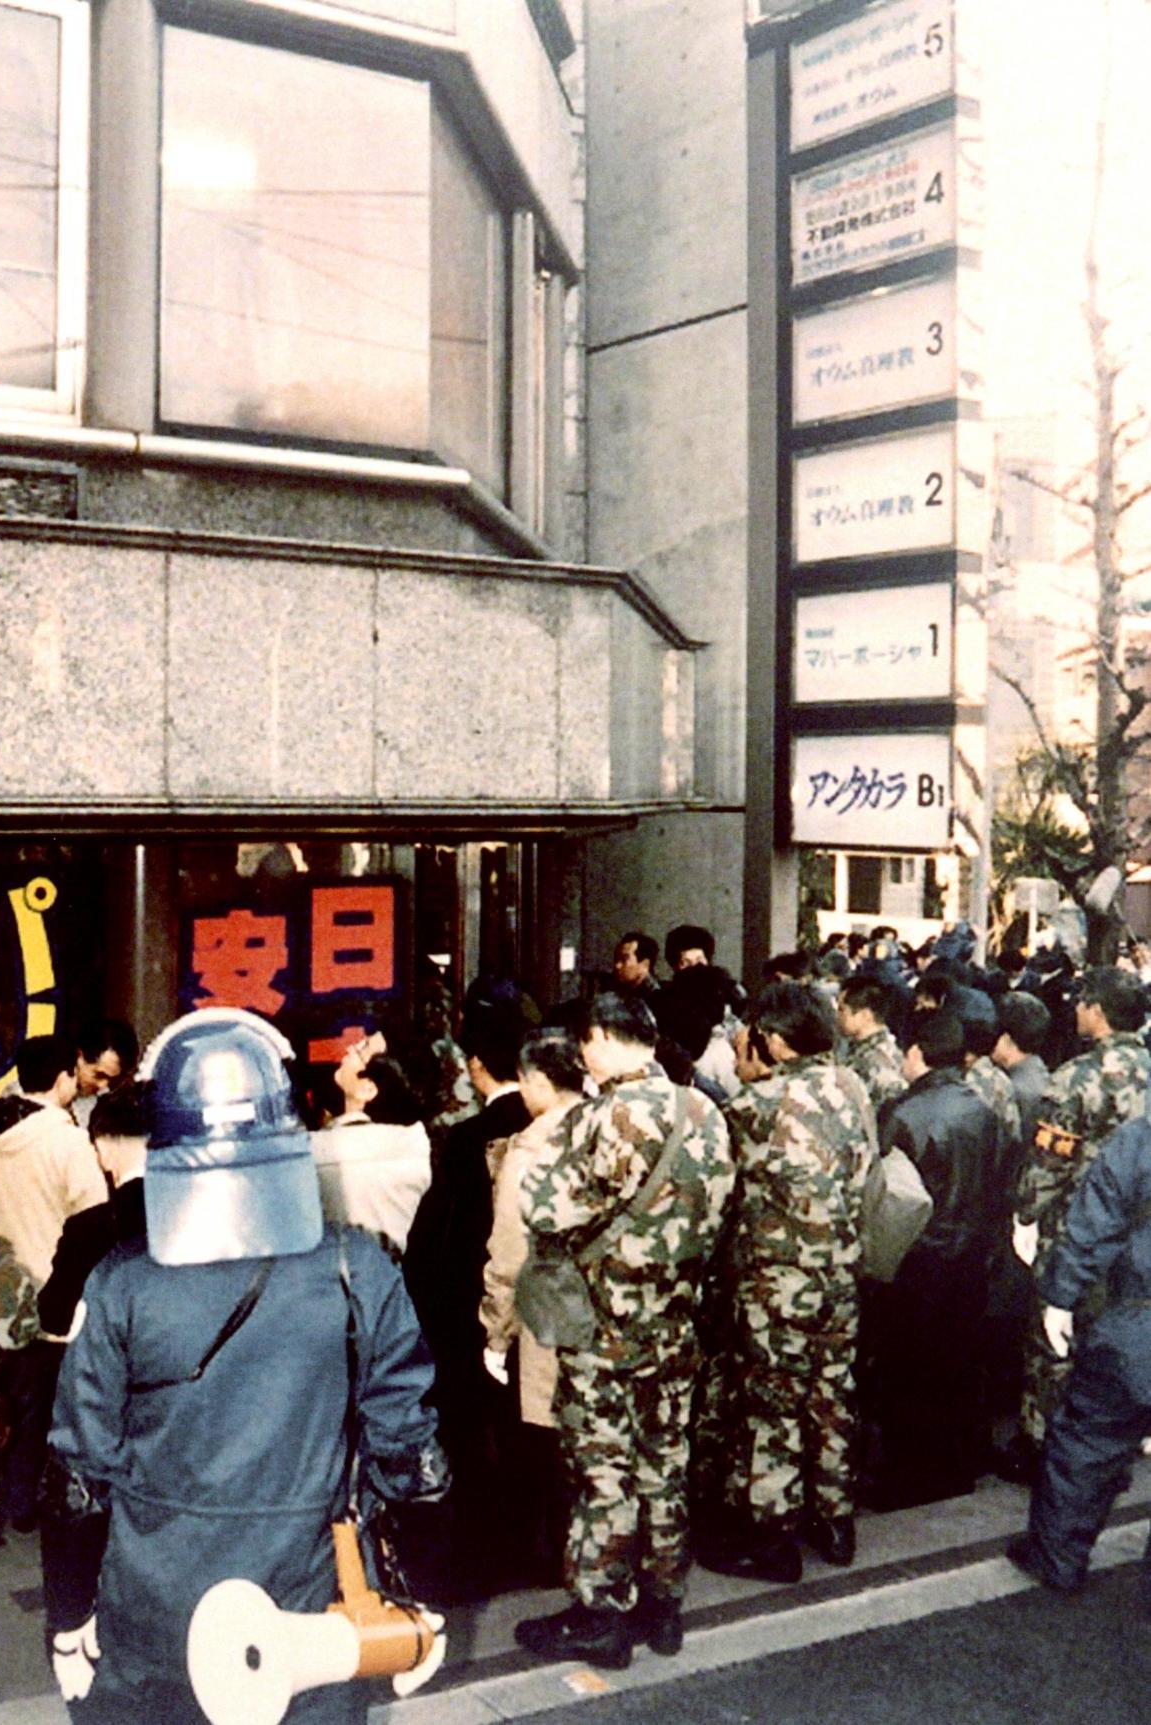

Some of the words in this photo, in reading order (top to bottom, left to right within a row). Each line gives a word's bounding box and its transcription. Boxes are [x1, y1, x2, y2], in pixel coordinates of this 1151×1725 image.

[923, 23, 944, 58] 5
[923, 171, 945, 204] 4
[925, 321, 944, 356] 3
[924, 471, 944, 507] 2
[928, 623, 939, 657] 1
